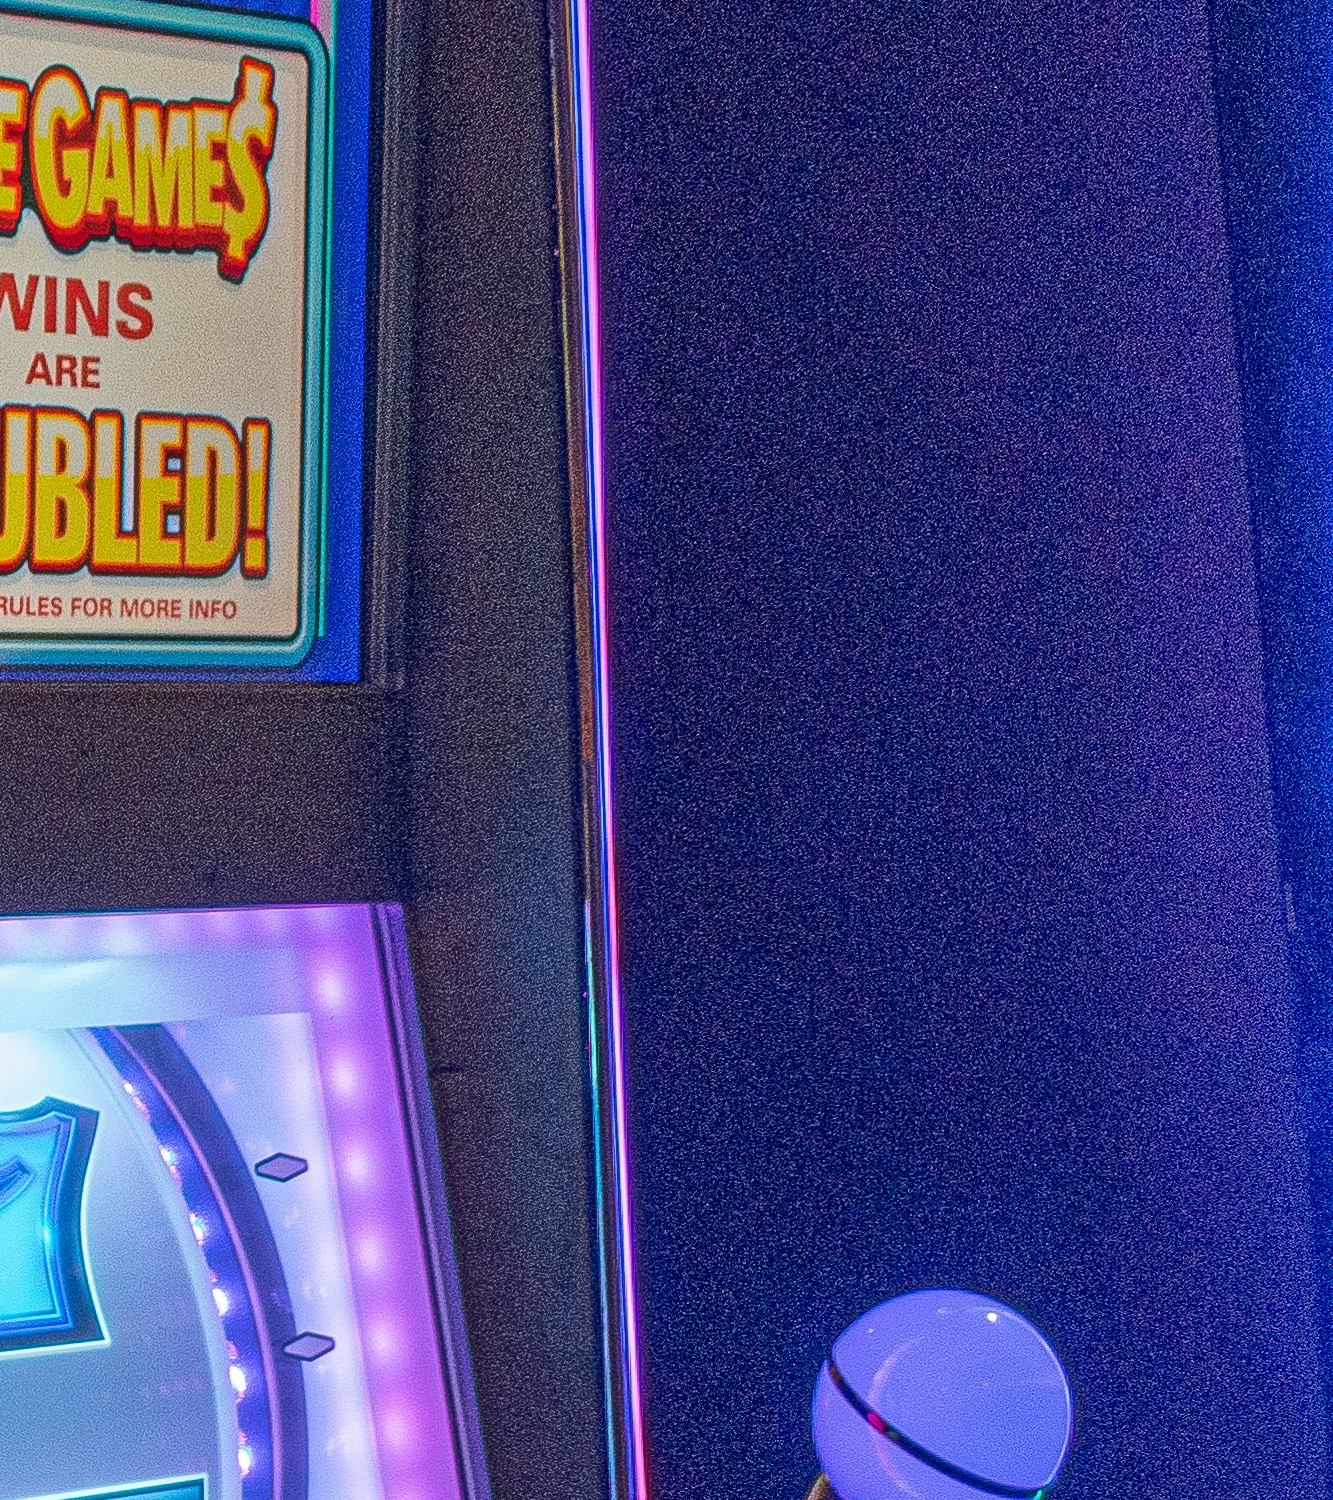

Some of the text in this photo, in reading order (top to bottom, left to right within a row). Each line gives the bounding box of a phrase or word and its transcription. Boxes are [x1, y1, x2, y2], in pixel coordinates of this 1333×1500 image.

[26, 353, 101, 389] ARE
[71, 596, 113, 618] FOR
[119, 596, 183, 620] MORE
[189, 598, 237, 621] INFO
